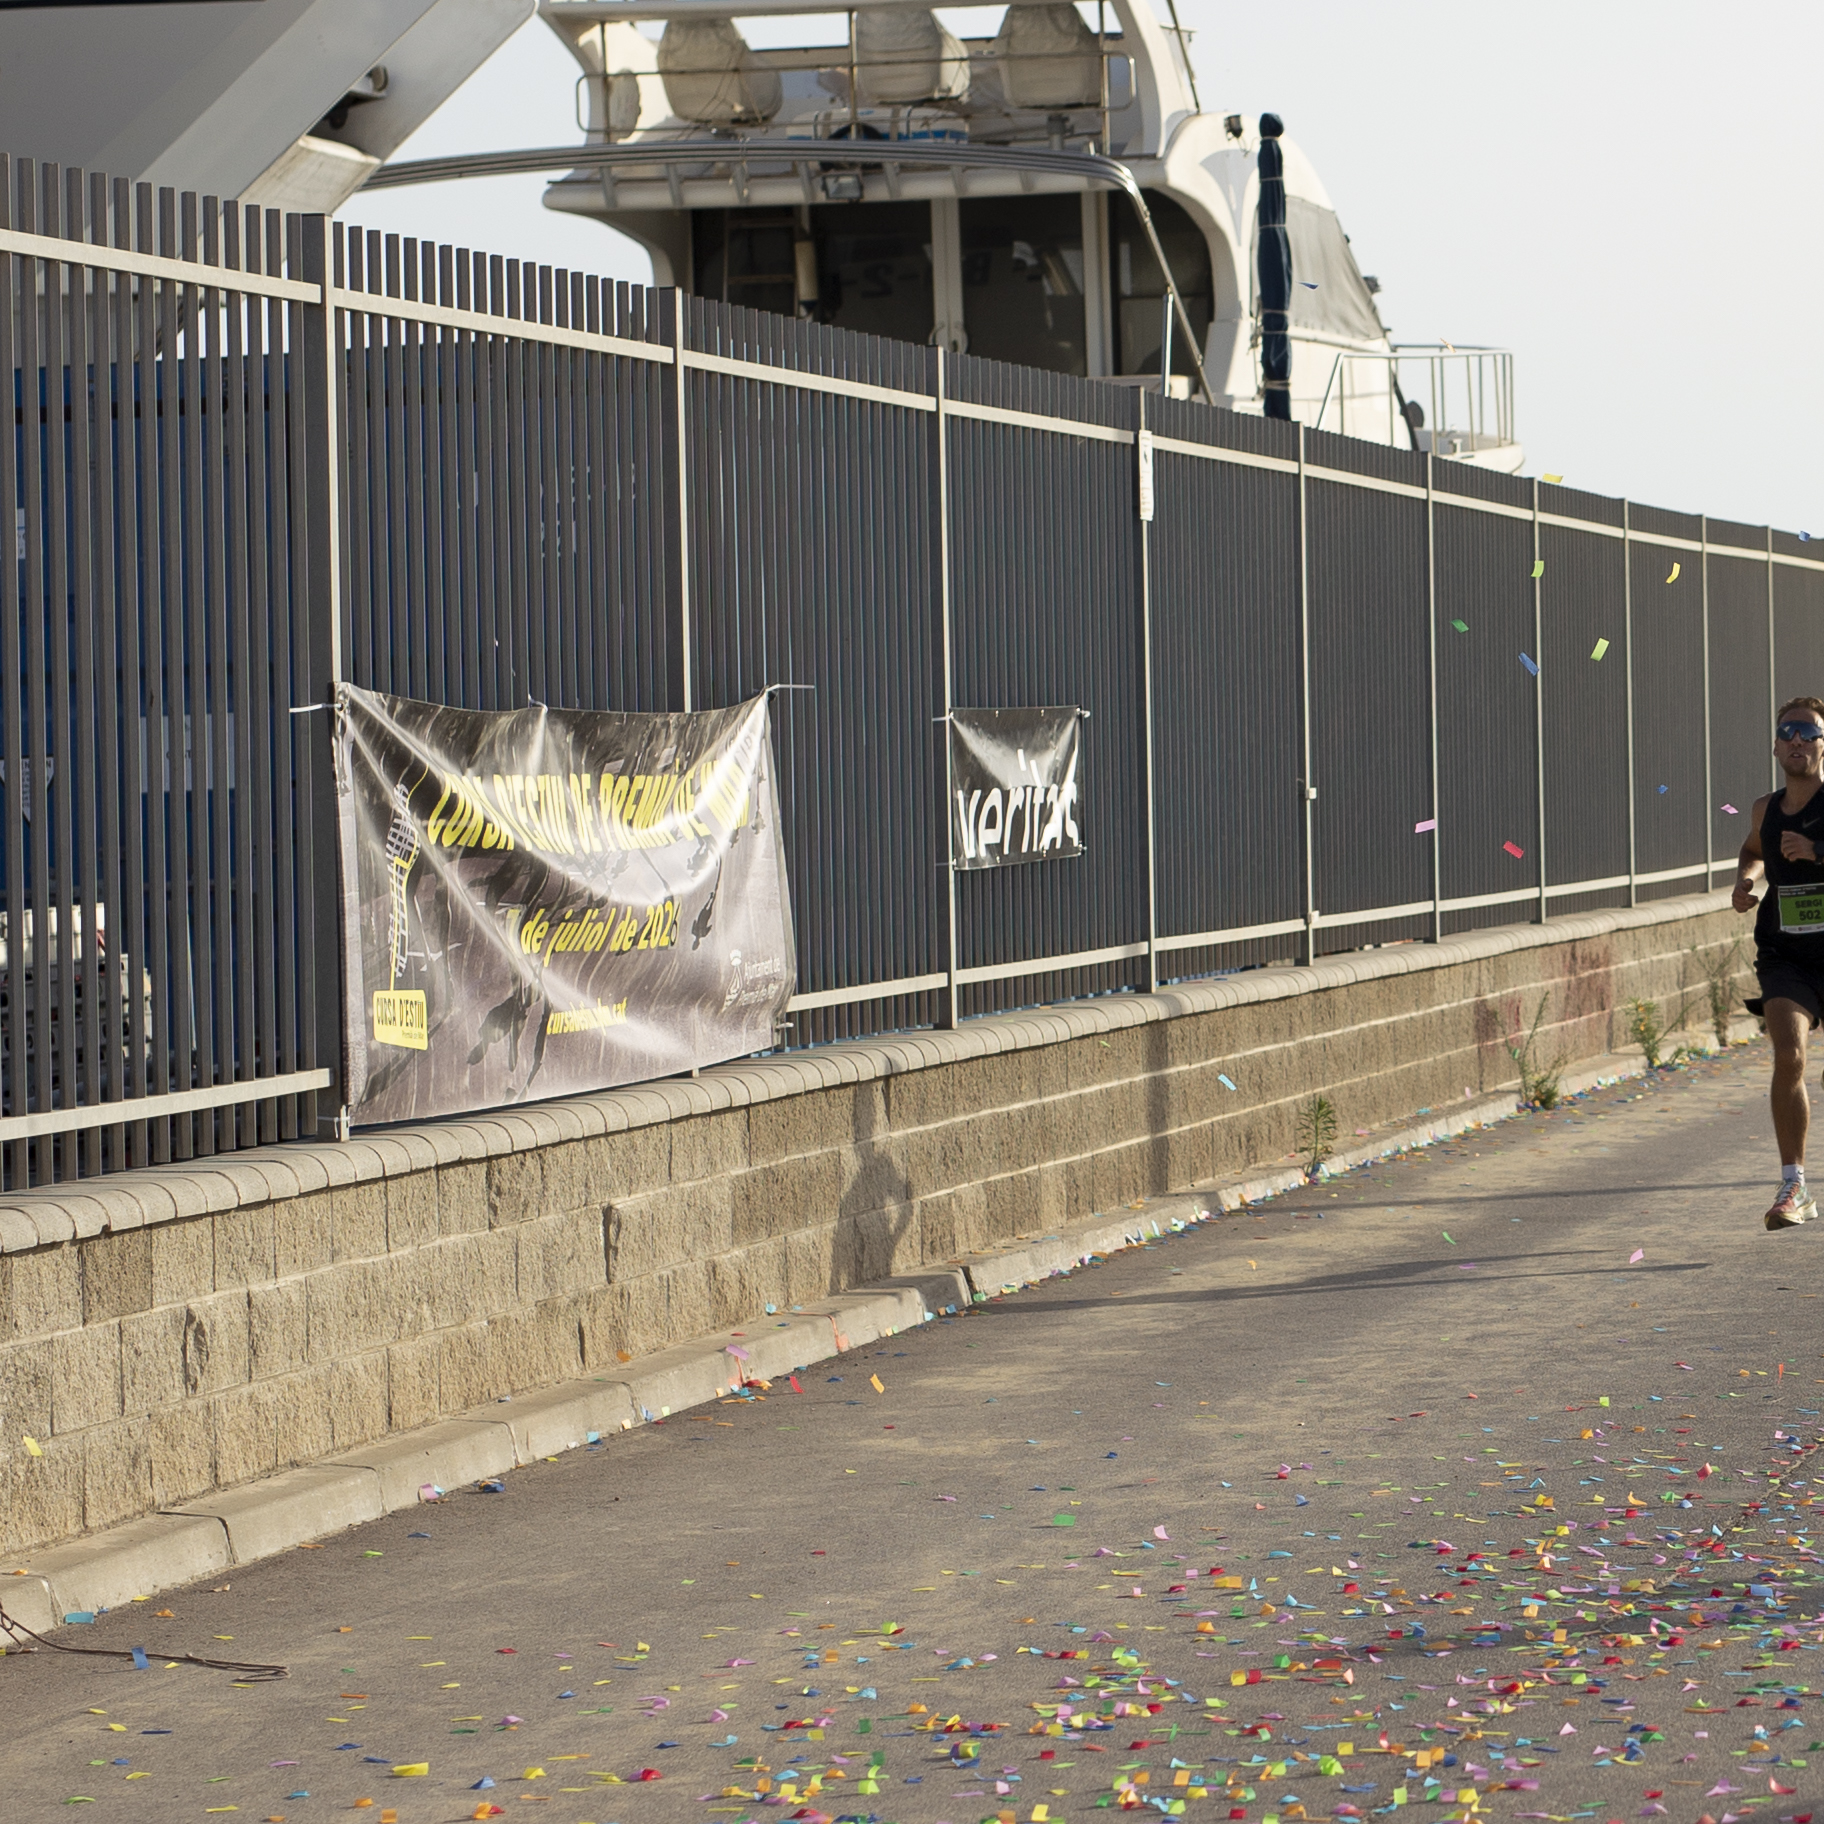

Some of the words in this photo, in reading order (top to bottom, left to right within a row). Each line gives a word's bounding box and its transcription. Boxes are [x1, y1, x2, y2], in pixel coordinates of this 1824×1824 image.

[569, 773, 602, 855] DE
[956, 748, 1079, 859] veritas
[1795, 899, 1822, 909] SERGI
[1799, 909, 1821, 921] 502
[520, 908, 550, 955] de
[543, 907, 617, 968] juliol
[609, 906, 639, 953] de
[376, 996, 397, 1027] CURSA
